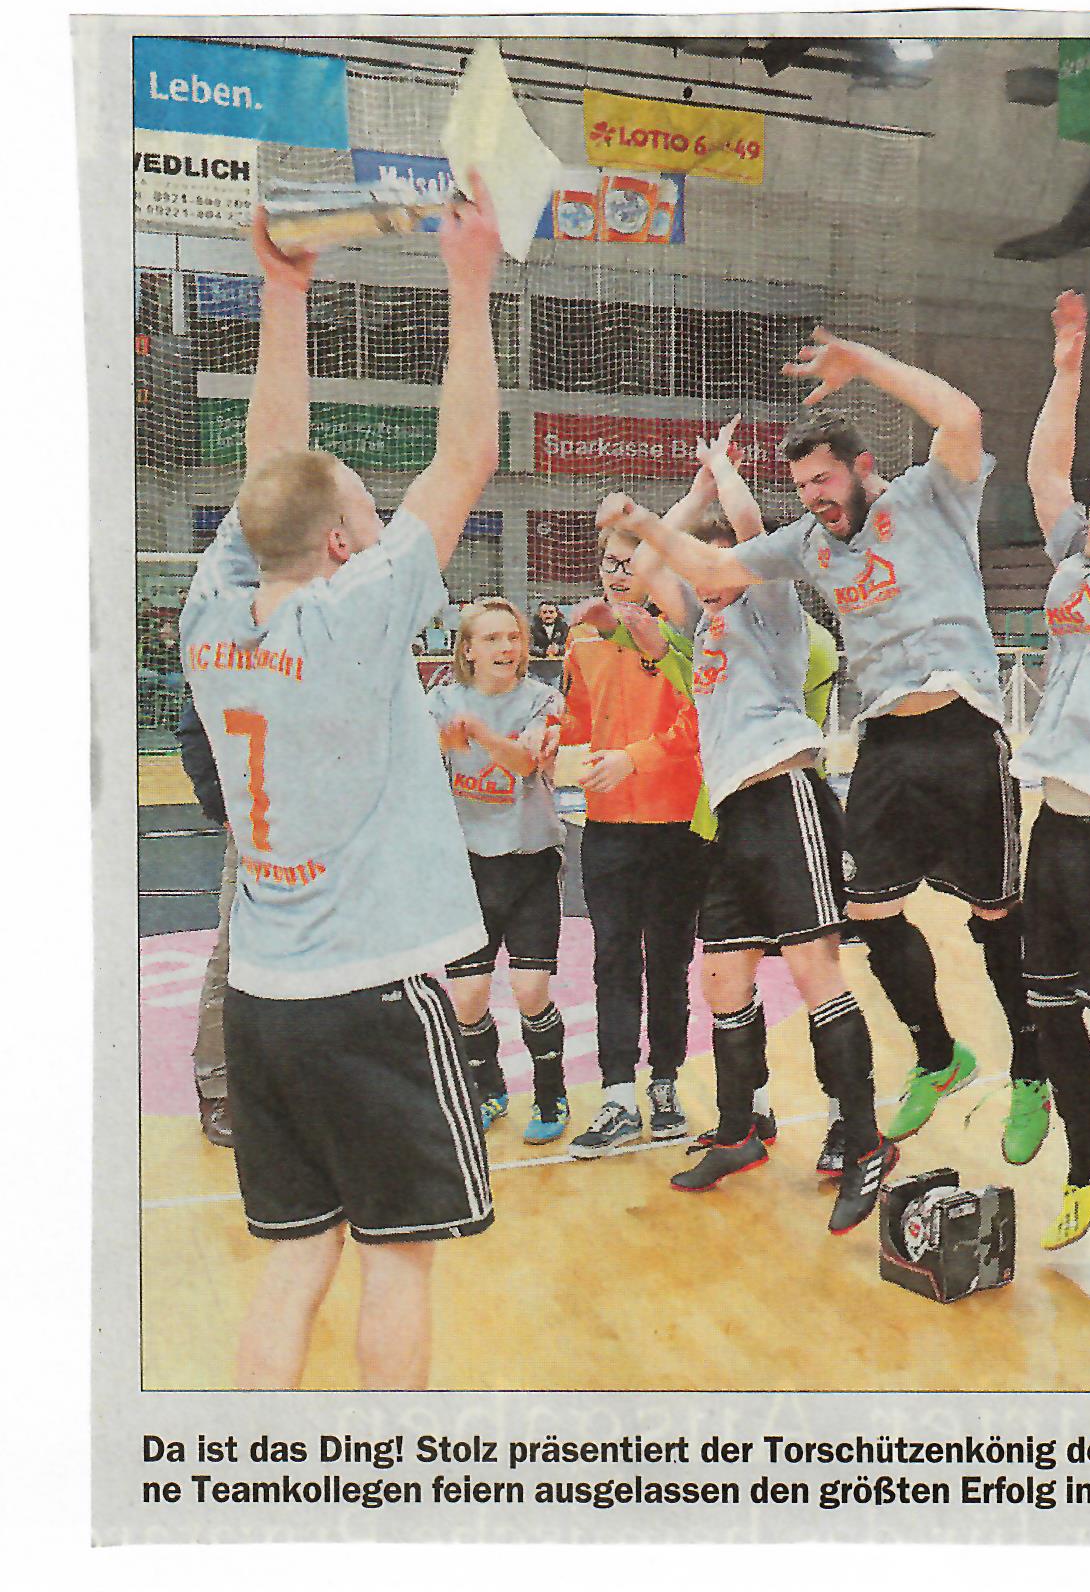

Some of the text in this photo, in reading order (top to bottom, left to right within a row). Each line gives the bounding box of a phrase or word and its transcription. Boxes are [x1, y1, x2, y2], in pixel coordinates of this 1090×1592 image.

[148, 70, 264, 111] Leben.
[619, 125, 690, 153] LOTTO
[136, 151, 250, 182] EDLICH
[543, 433, 664, 461] Sparkasse
[223, 708, 273, 853] 7
[142, 1433, 186, 1464] Da
[197, 1433, 239, 1464] ist
[248, 1434, 309, 1464] das
[319, 1433, 405, 1471] Ding!
[415, 1434, 499, 1464] Stolz
[508, 1433, 691, 1471] präsentiert
[699, 1434, 755, 1465] der
[762, 1434, 1058, 1471] Torschützenkönig
[142, 1480, 183, 1504] ne
[190, 1474, 423, 1510] Teamkollegen
[430, 1473, 525, 1505] feiern
[533, 1474, 741, 1510] ausgelassen
[749, 1474, 810, 1505] den
[818, 1474, 951, 1511] größten
[960, 1474, 1058, 1511] Erfolg
